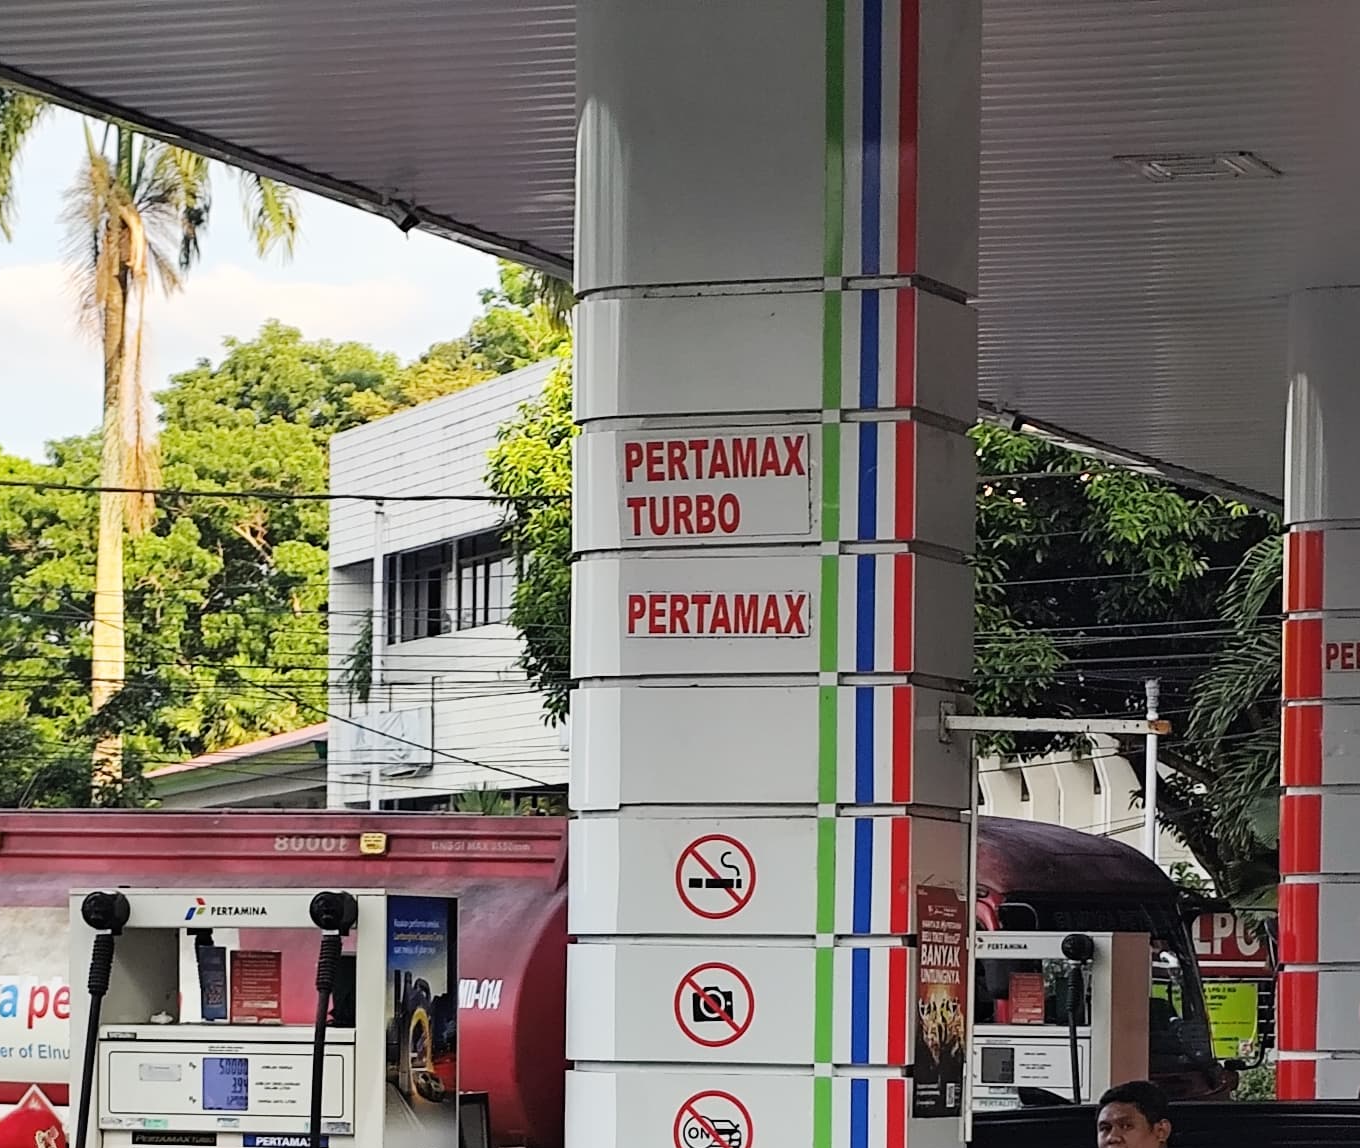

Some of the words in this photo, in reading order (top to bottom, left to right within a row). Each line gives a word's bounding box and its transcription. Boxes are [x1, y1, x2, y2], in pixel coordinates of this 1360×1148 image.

[624, 435, 806, 482] PERTAMAX
[626, 493, 741, 536] TURBO
[627, 594, 806, 634] PERTAMAX
[211, 906, 268, 917] PERTAMINA
[921, 943, 960, 967] BANYAK
[920, 967, 960, 985] UNTUNGNYA
[19, 1044, 33, 1059] of
[687, 1126, 710, 1139] ON
